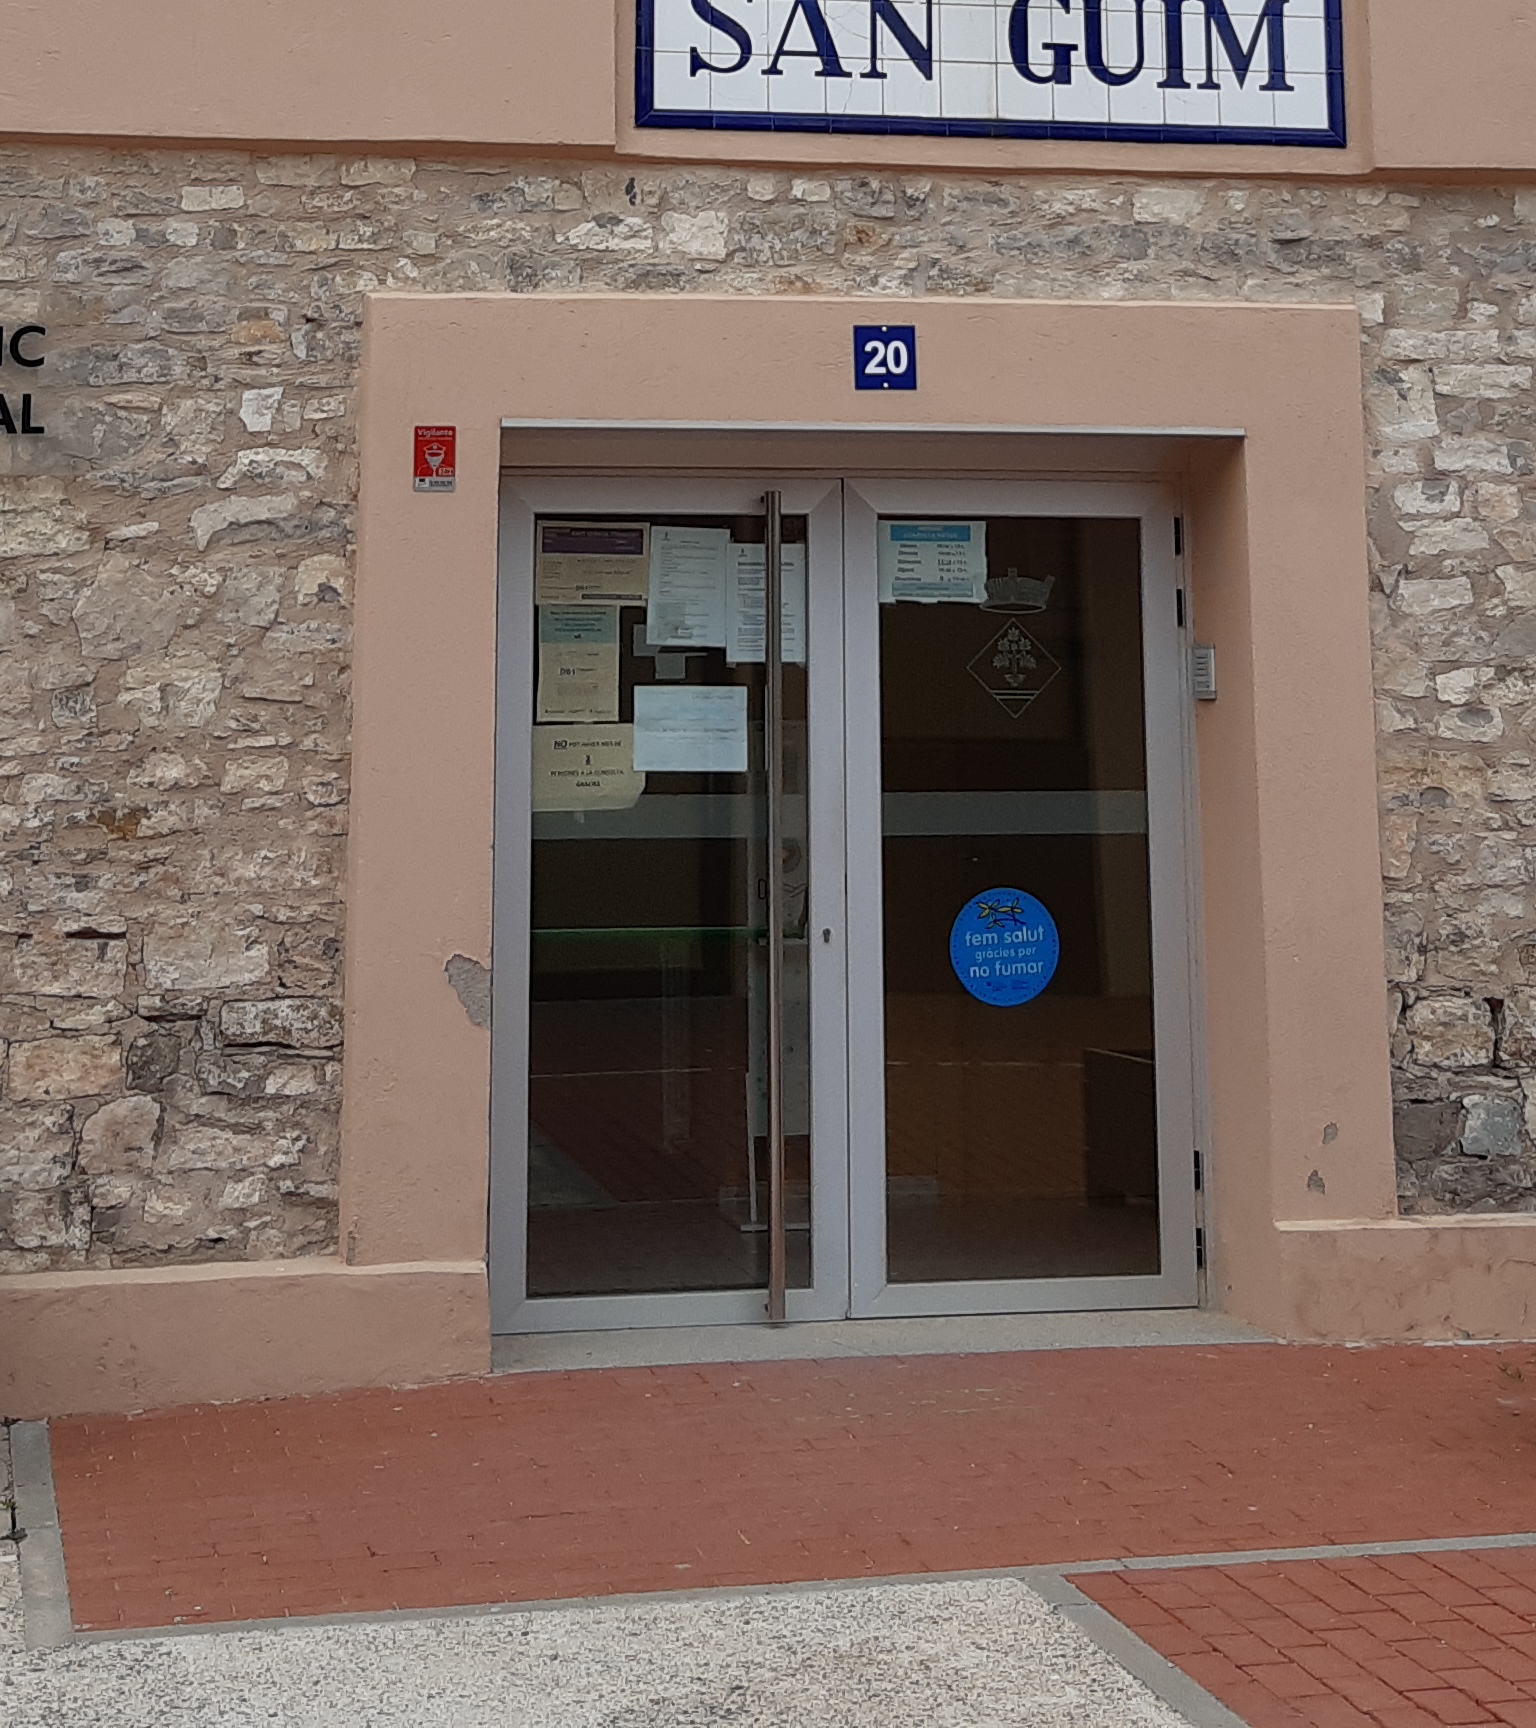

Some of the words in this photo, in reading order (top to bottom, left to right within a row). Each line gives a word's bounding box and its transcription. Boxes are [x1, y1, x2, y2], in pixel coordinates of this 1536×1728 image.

[865, 340, 908, 374] 20
[554, 739, 568, 750] NO
[965, 931, 998, 946] fem
[1004, 925, 1044, 944] salut
[1018, 947, 1037, 958] per
[969, 965, 990, 978] no
[994, 960, 1044, 977] fumar
